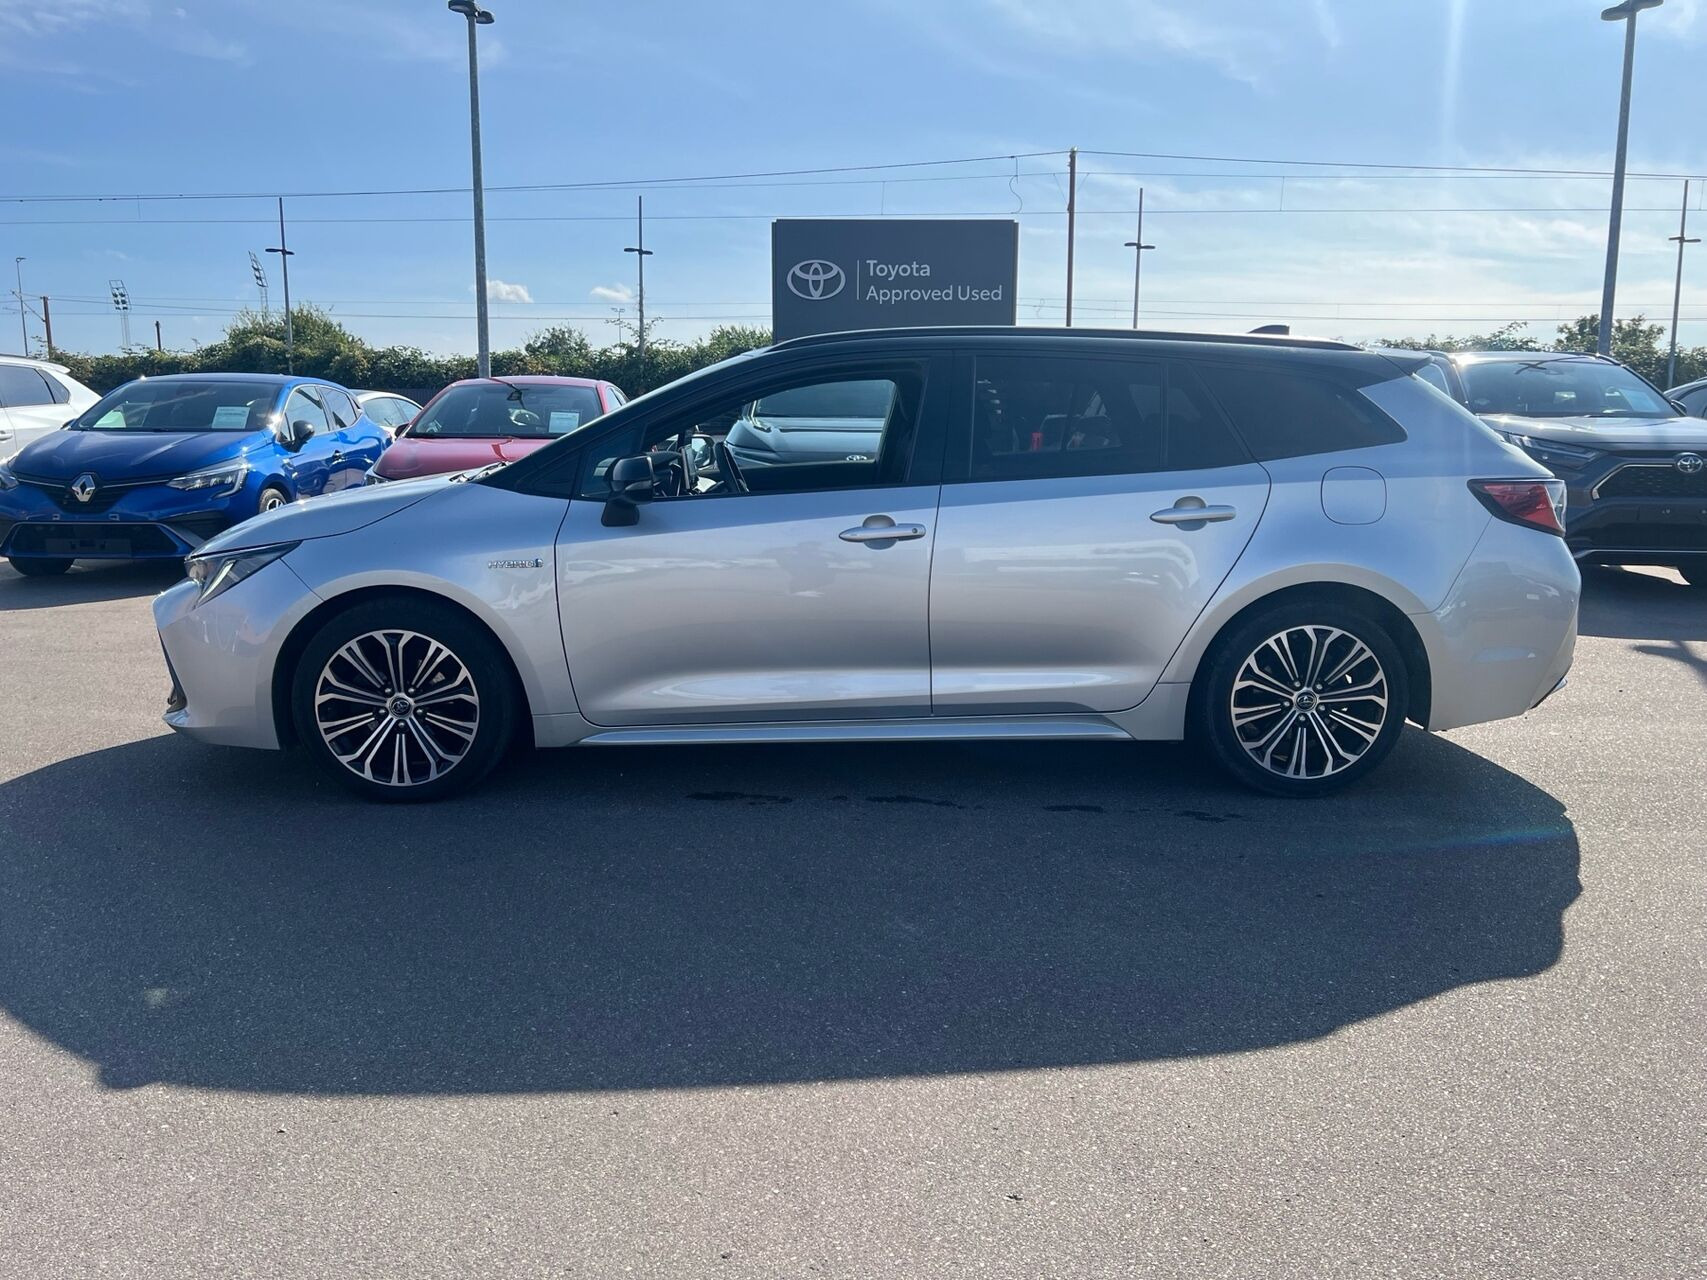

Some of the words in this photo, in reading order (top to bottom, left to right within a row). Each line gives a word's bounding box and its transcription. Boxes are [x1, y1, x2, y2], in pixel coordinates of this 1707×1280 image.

[866, 260, 930, 280] Toyota
[866, 285, 952, 304] Approved
[958, 285, 1002, 301] Used
[488, 560, 534, 569] HYBRID
